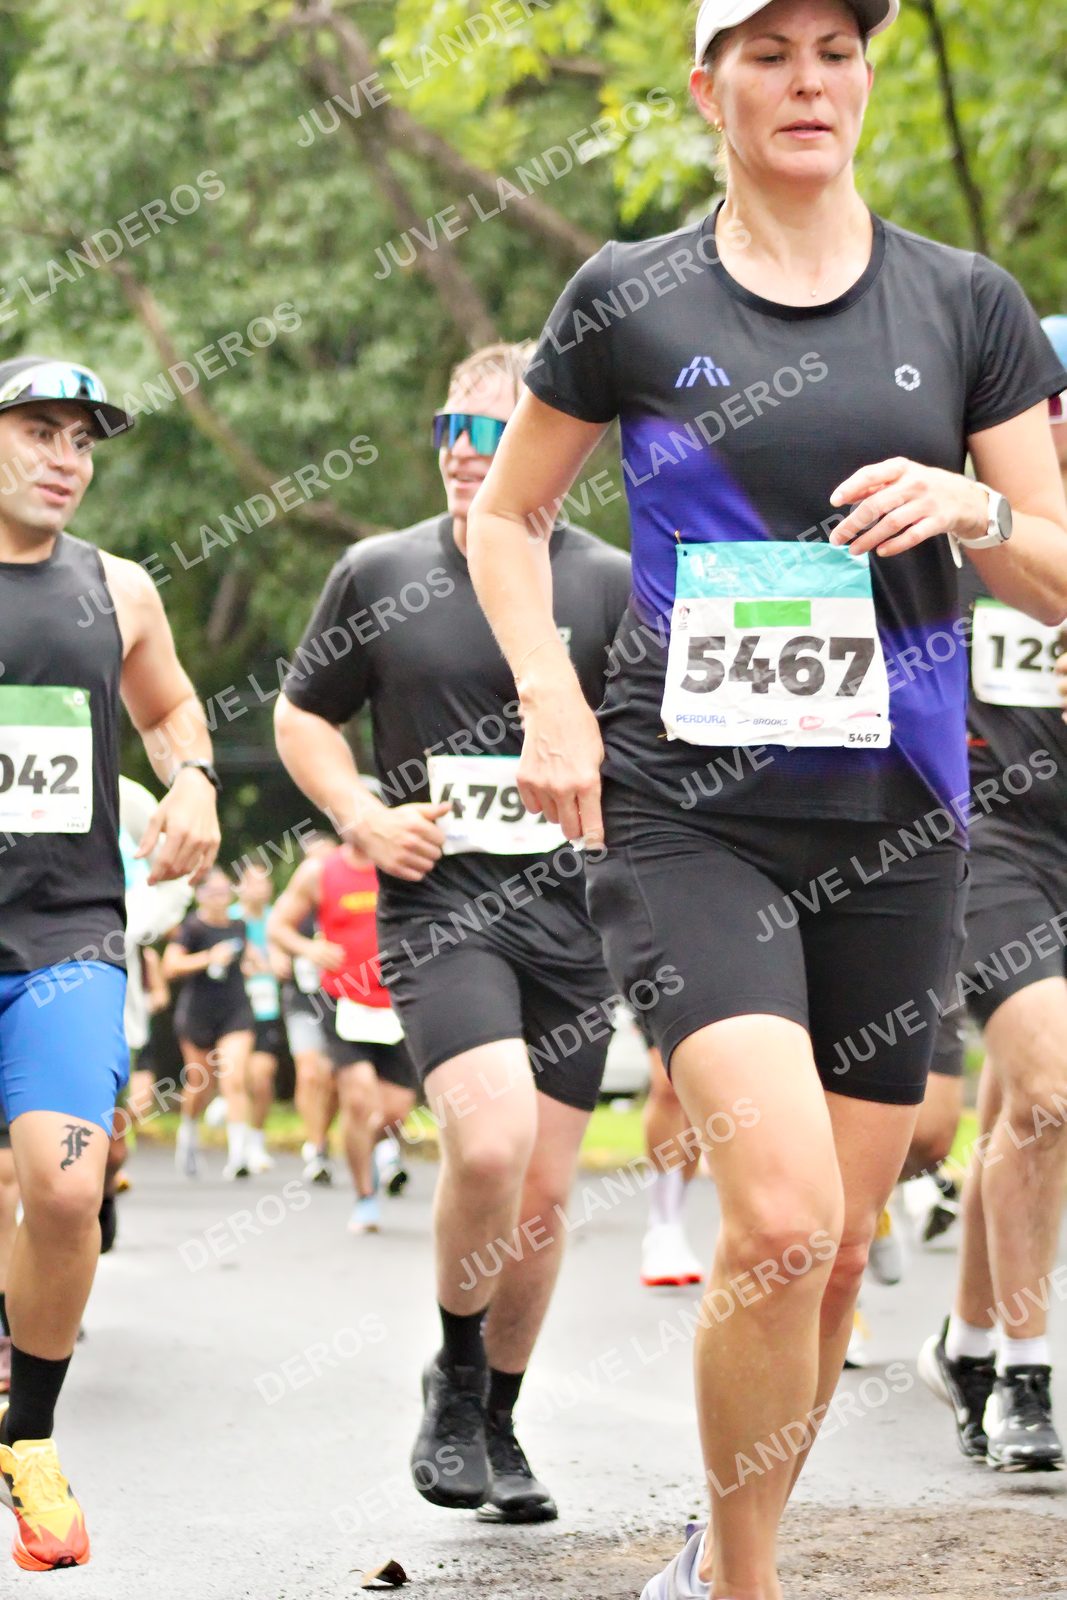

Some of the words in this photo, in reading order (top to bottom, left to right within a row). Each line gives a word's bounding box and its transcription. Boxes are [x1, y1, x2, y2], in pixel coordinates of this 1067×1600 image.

[680, 635, 875, 697] 5467
[676, 714, 727, 725] PERDURA
[753, 718, 788, 726] BROOKS
[848, 733, 880, 743] 5467
[439, 783, 548, 823] 479
